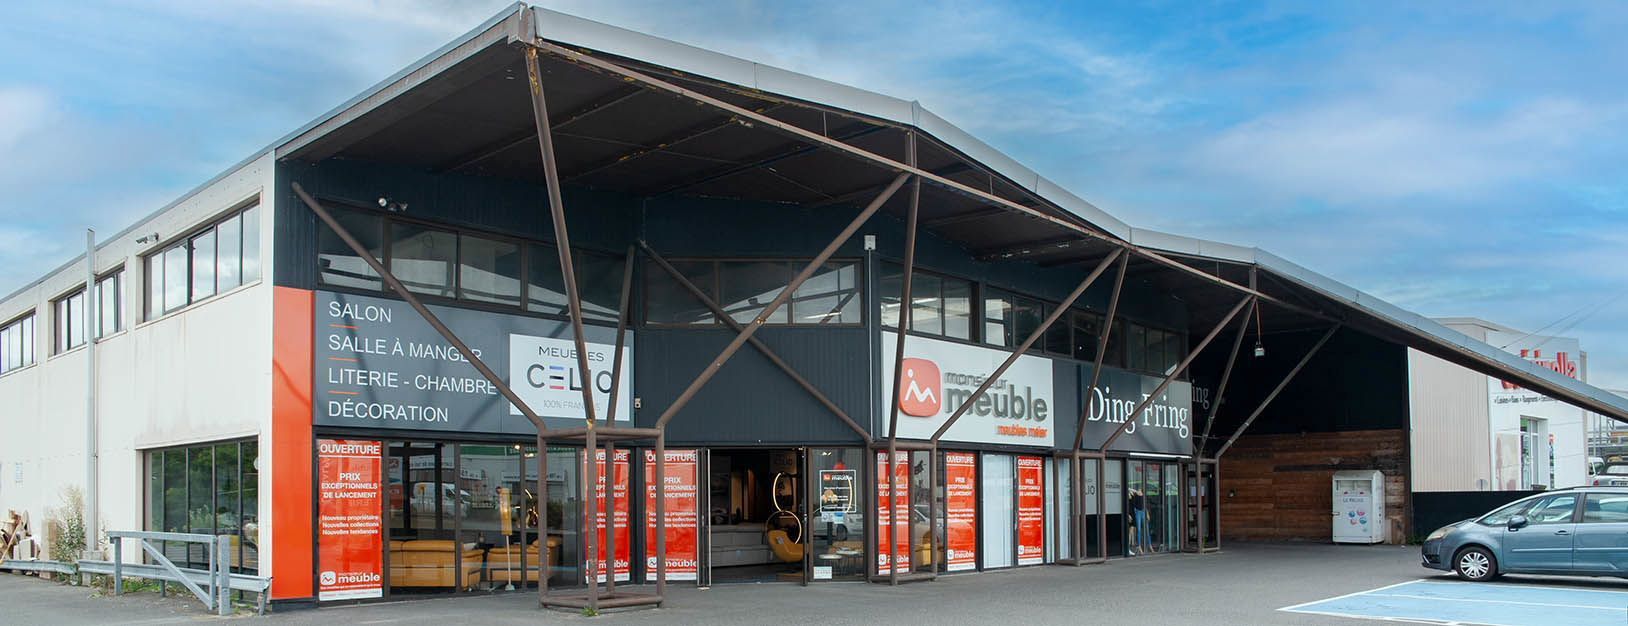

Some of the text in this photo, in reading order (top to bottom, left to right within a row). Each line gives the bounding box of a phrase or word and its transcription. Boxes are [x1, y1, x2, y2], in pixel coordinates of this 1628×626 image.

[329, 301, 392, 323] SALON
[328, 334, 387, 355] SALLE
[392, 338, 404, 356] À
[539, 346, 605, 361] MEUBES
[328, 367, 399, 388] LITERIE
[415, 374, 497, 395] CHAMBRE
[328, 398, 449, 423] DÉCORATION
[944, 384, 1048, 422] meuble
[1087, 386, 1136, 434] Ding
[1142, 393, 1189, 439] Fring
[320, 443, 380, 455] OUVERTURE
[321, 482, 378, 490] EXCEPTIONNELS
[339, 472, 361, 481] PRIX
[323, 491, 377, 499] DE LANCEMENT
[337, 572, 381, 584] meuble
